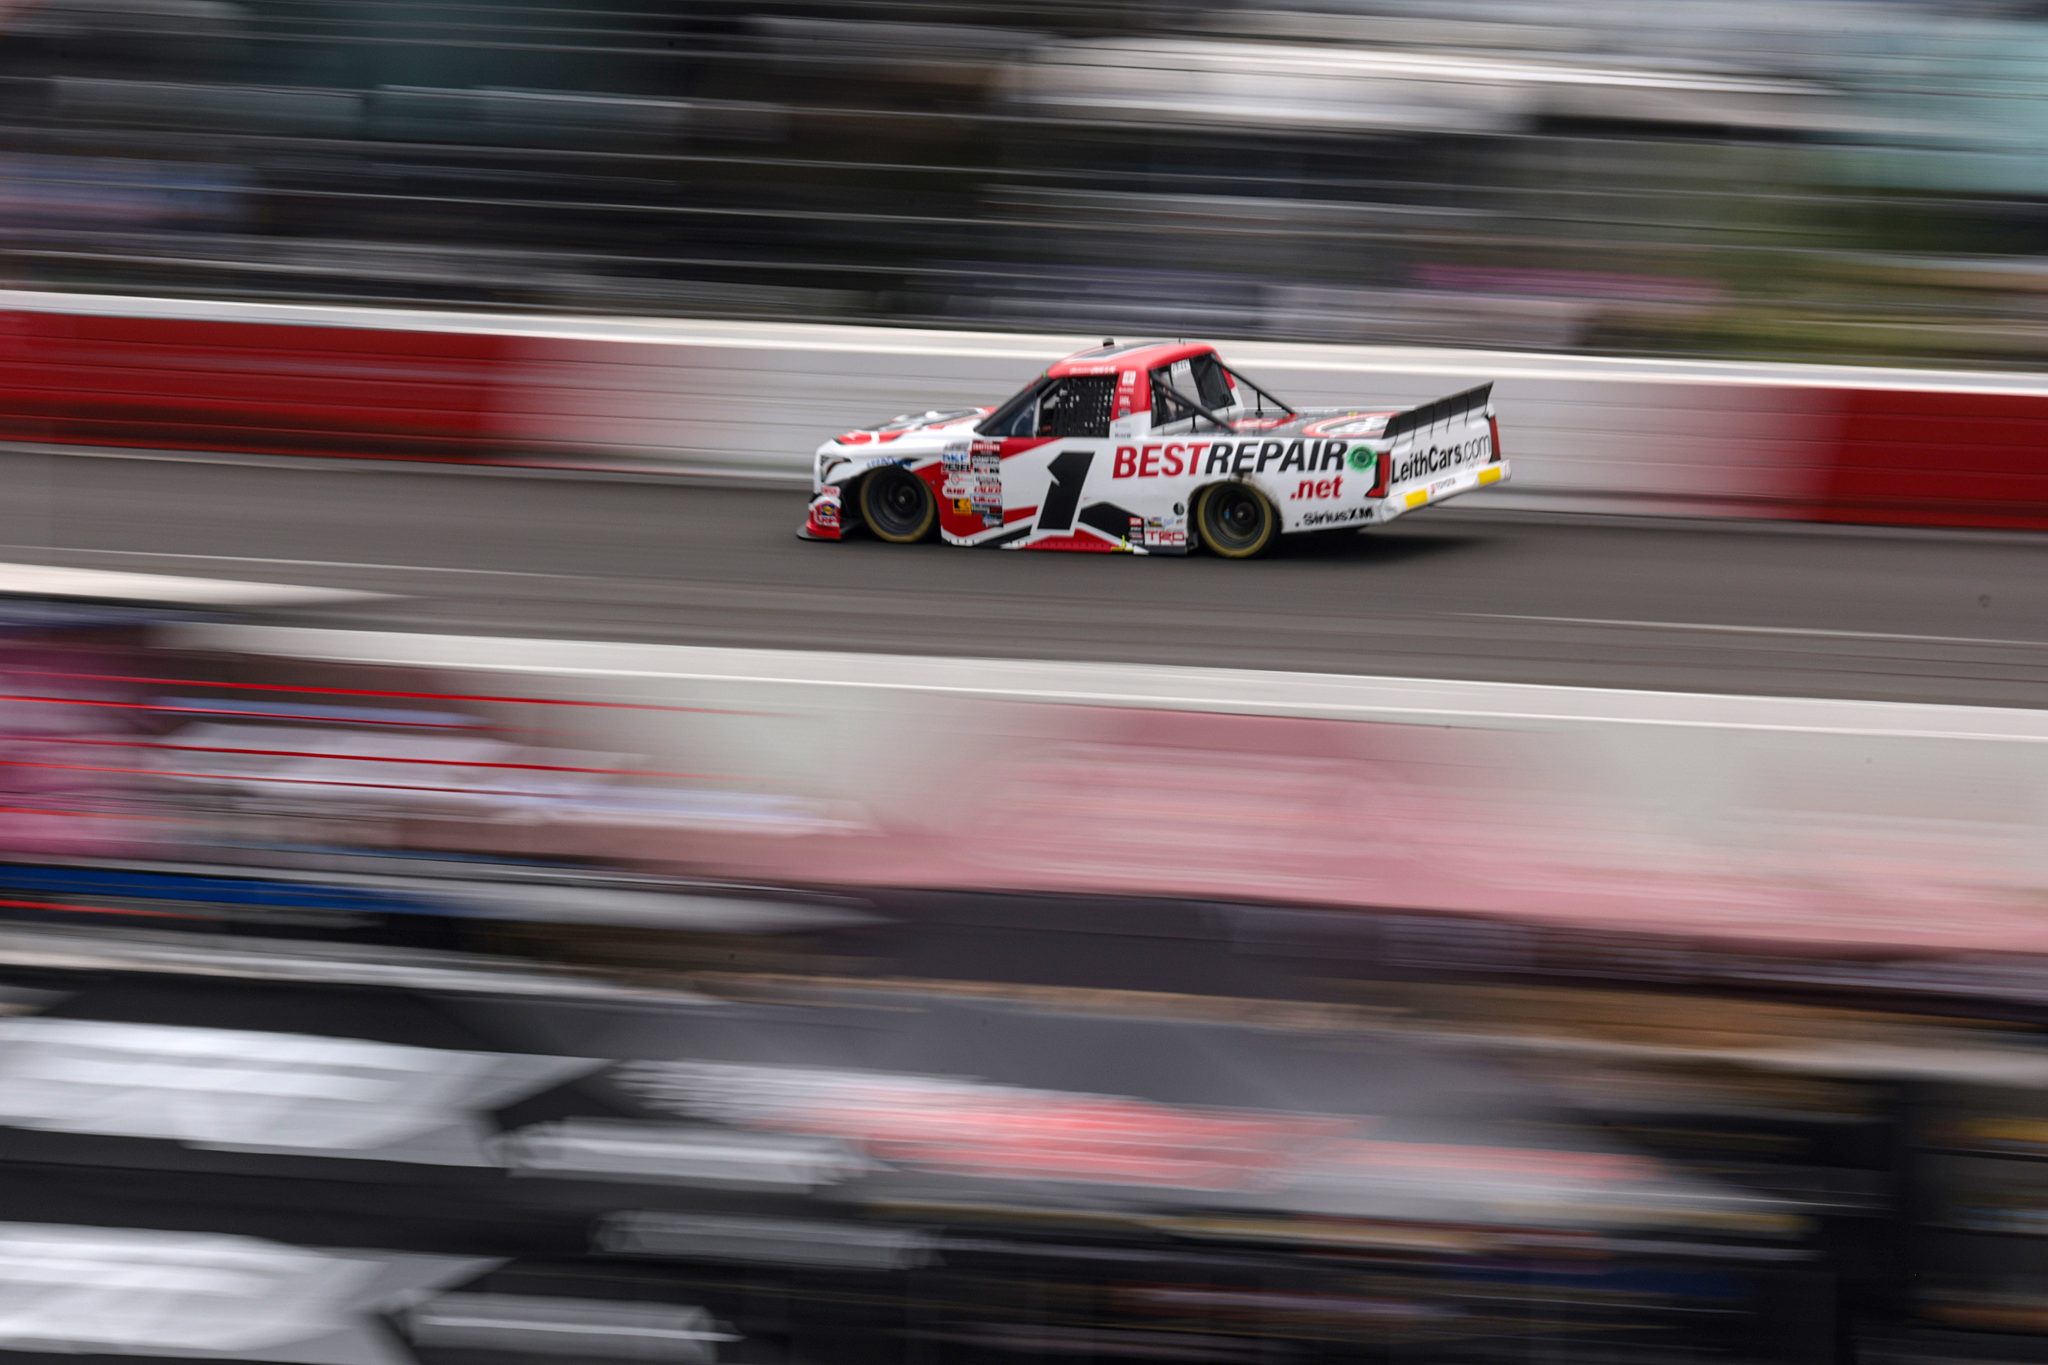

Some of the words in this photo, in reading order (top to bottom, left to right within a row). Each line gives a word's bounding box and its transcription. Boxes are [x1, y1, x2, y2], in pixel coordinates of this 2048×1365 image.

[1112, 439, 1348, 479] BESTREPAIR
[1391, 435, 1491, 484] LeithCars.com
[1037, 451, 1095, 530] 1
[1290, 475, 1343, 499] .net
